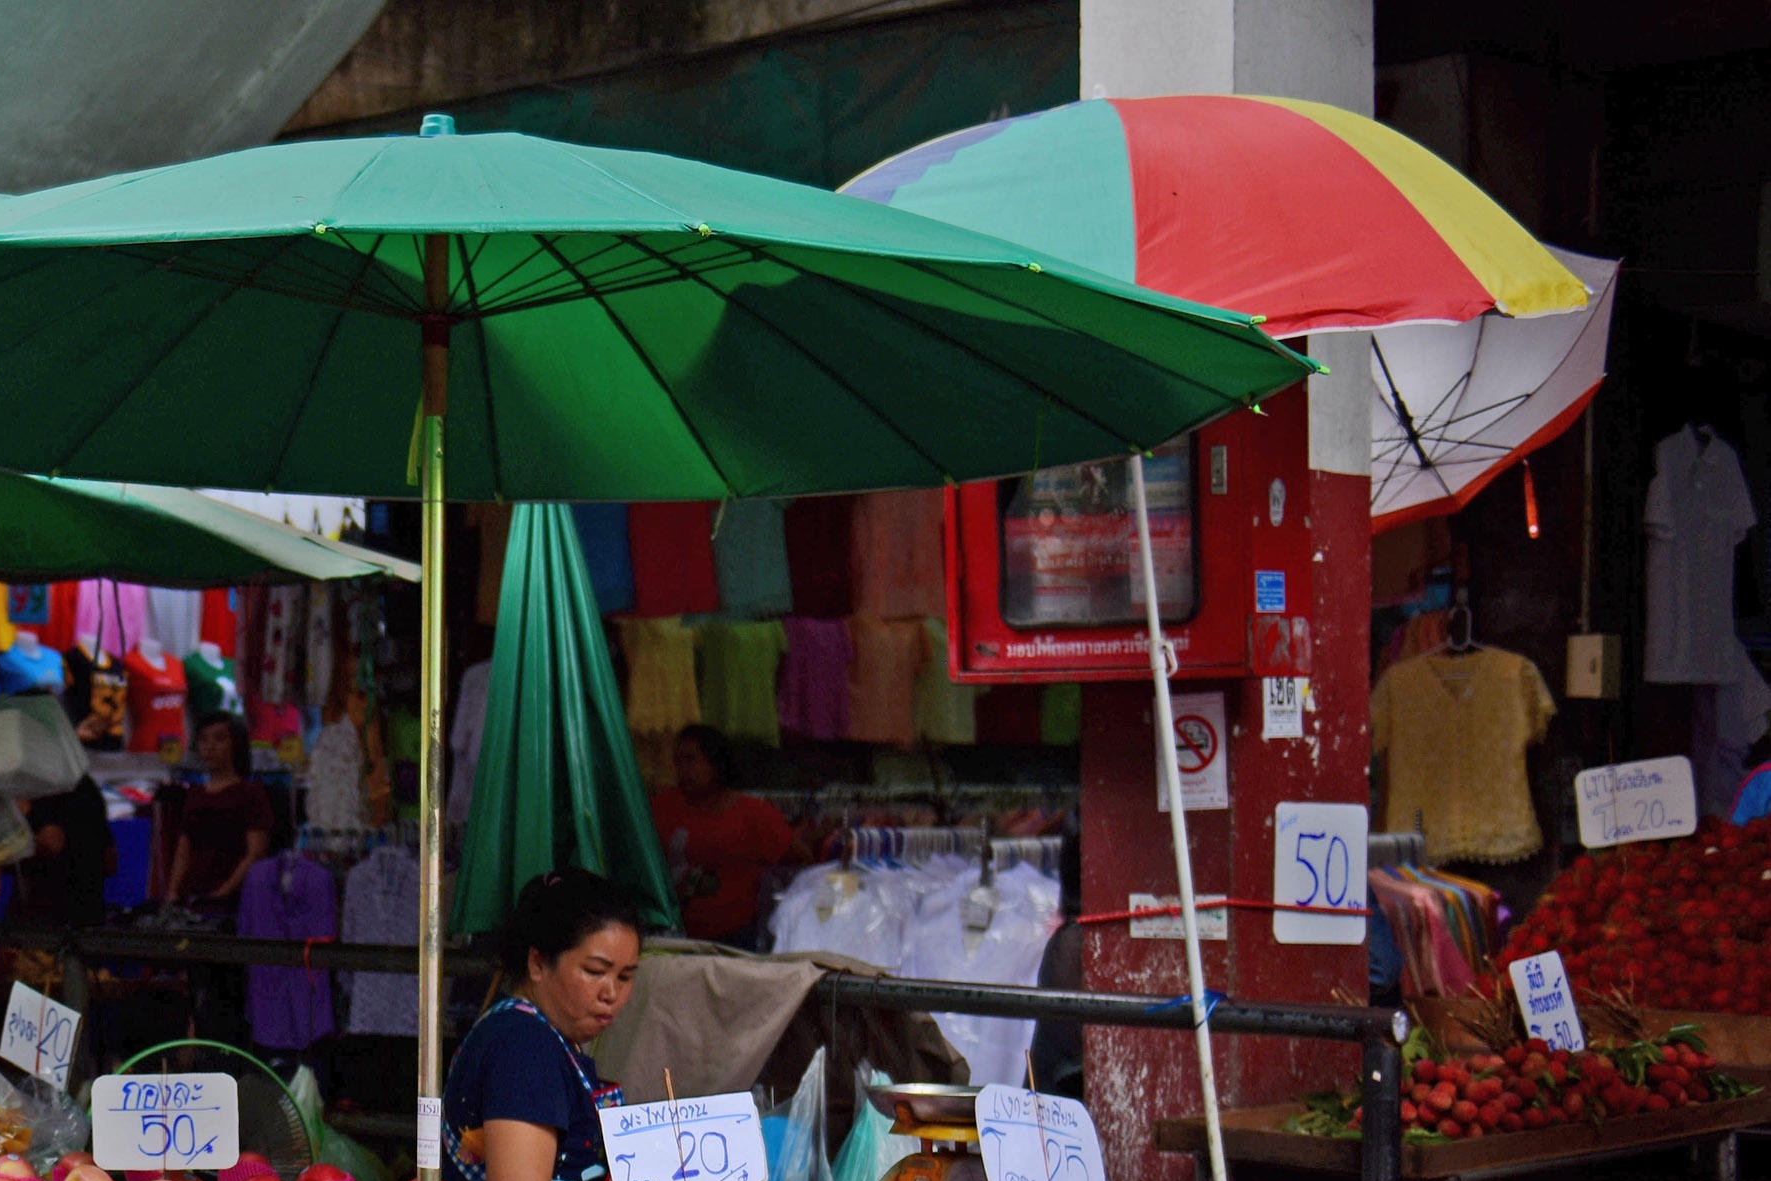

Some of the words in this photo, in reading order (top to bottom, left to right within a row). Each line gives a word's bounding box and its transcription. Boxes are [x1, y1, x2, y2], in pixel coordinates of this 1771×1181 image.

[1634, 799, 1665, 831] 20
[1295, 832, 1349, 907] 50
[122, 1081, 204, 1110] กองละ
